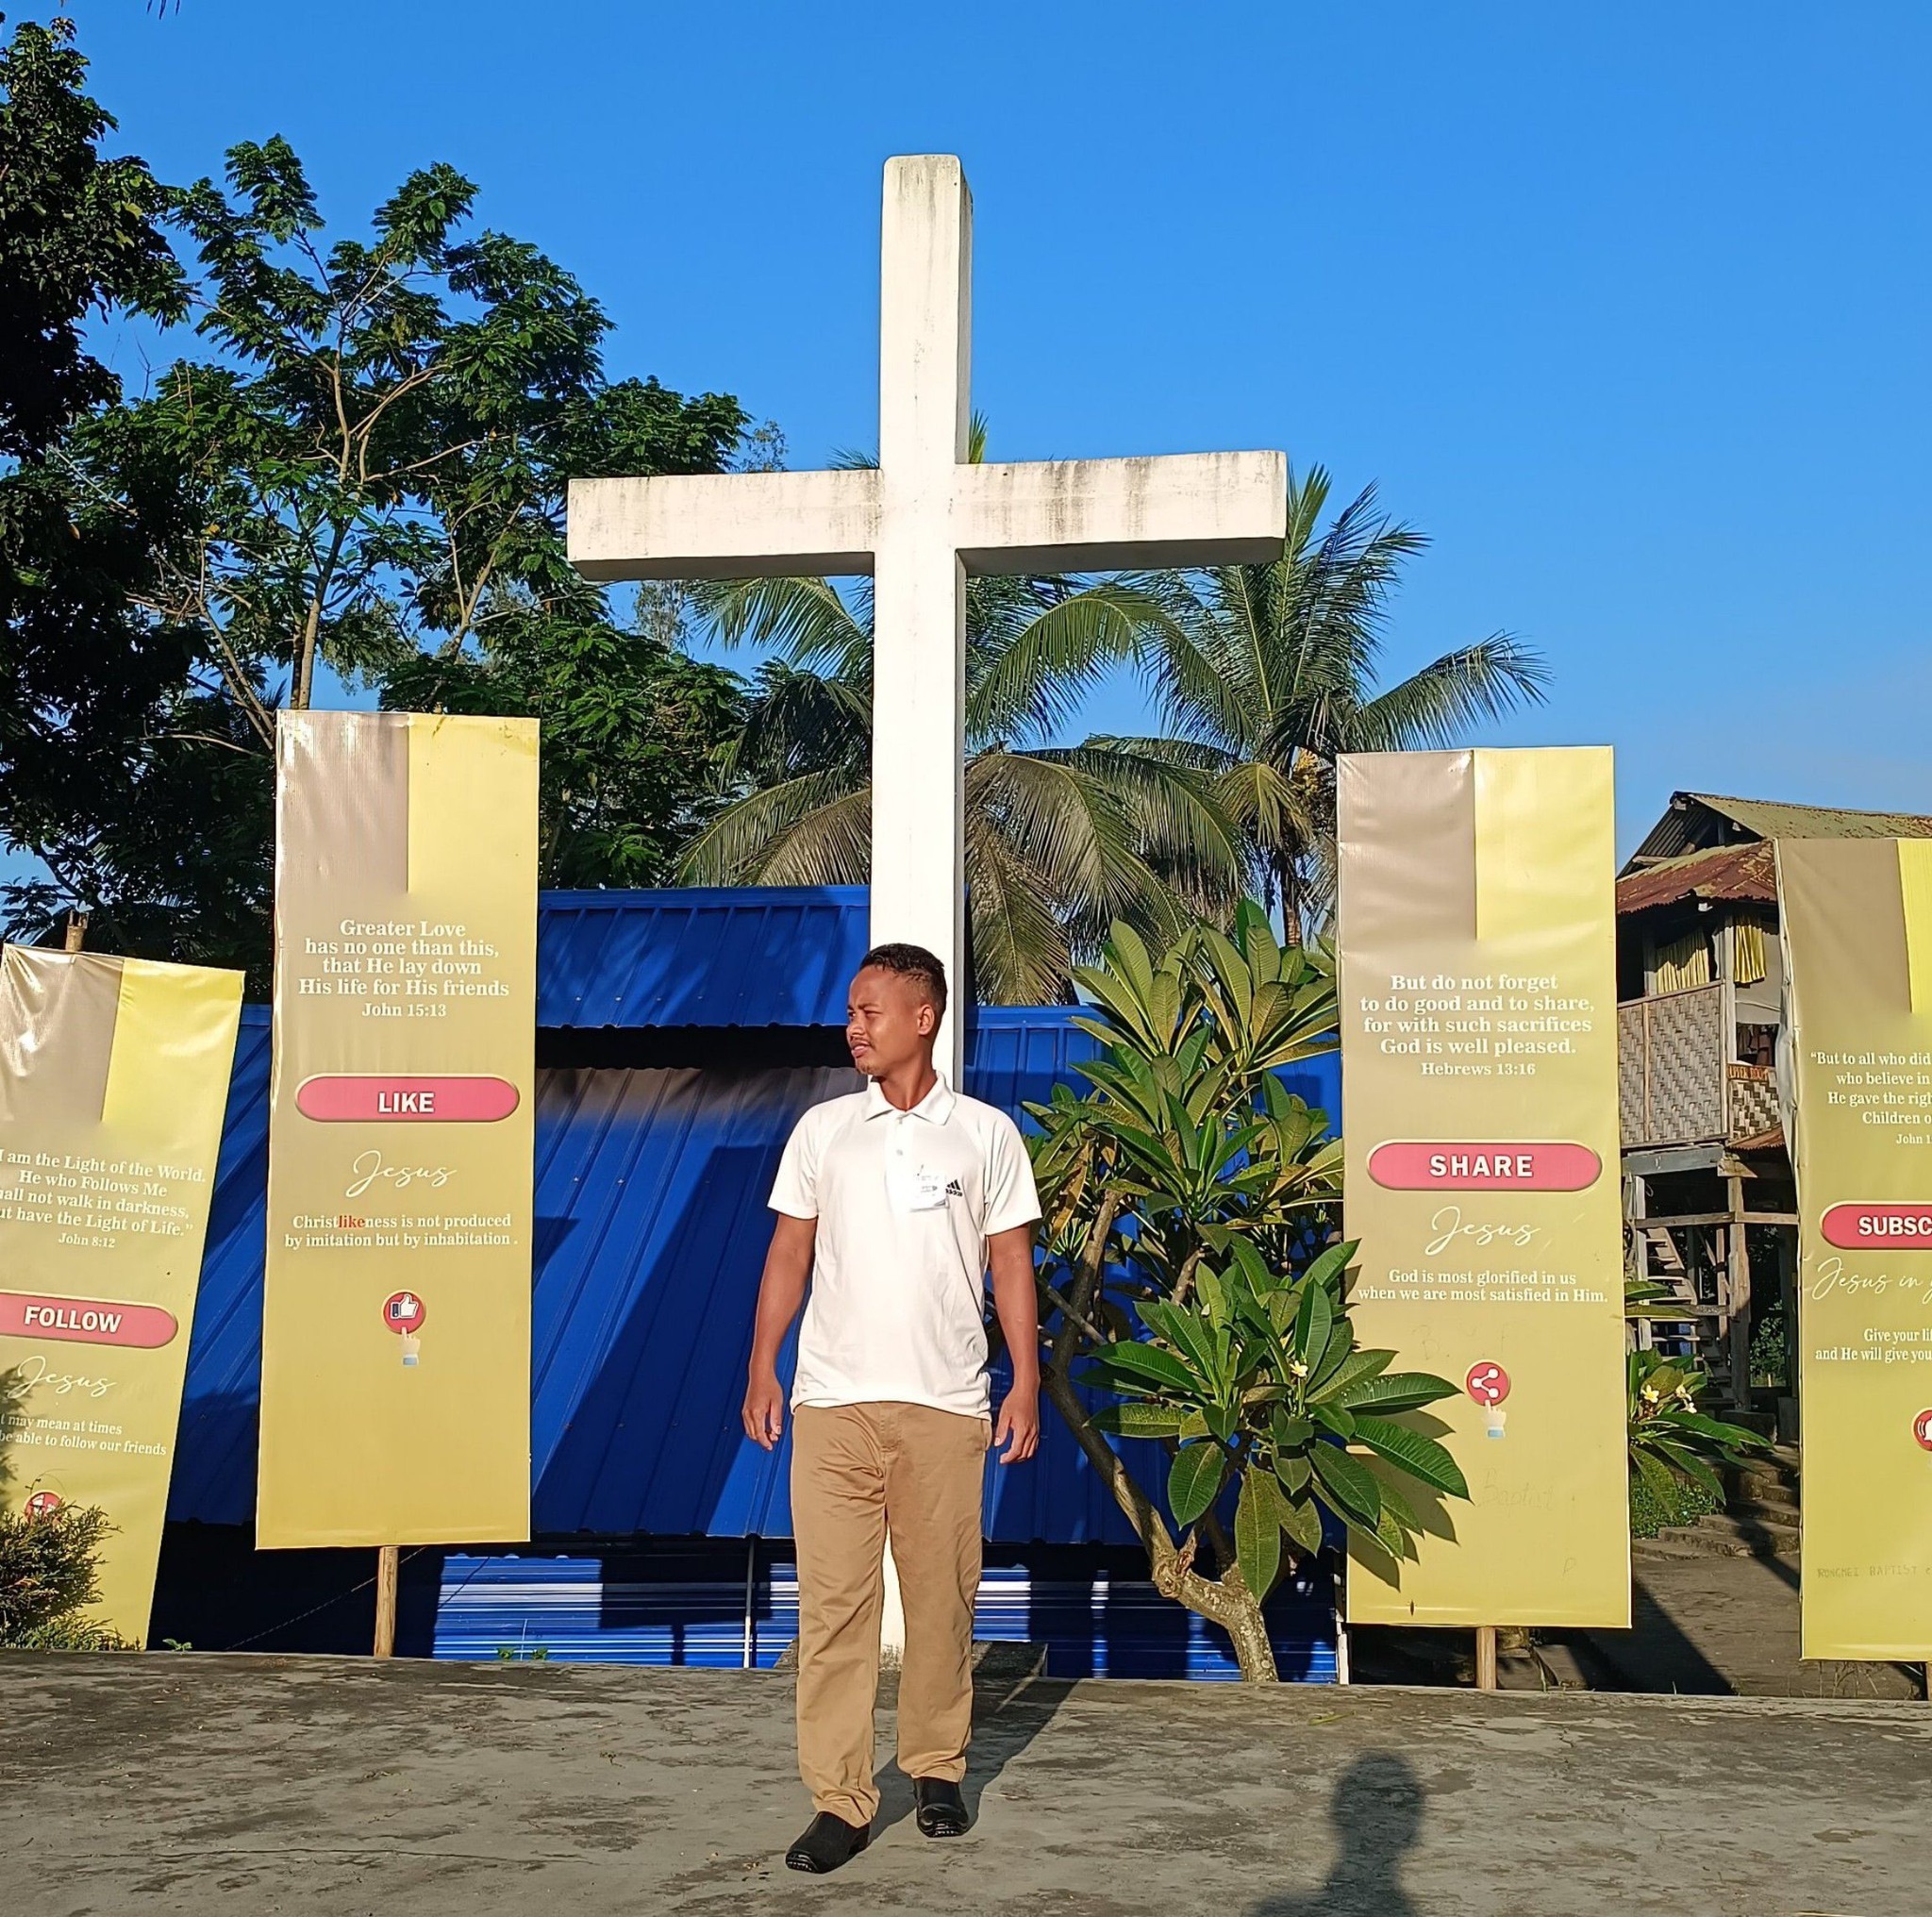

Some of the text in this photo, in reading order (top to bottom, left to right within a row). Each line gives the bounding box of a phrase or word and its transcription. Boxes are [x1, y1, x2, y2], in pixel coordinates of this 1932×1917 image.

[340, 919, 466, 936] Greater Love
[305, 938, 499, 958] has no one than this,
[323, 958, 482, 977] that He lay down
[298, 978, 509, 996] His life for His friends
[1391, 974, 1558, 992] But do not forget
[362, 1003, 447, 1017] John 15:13
[1360, 995, 1595, 1015] to do good and to share,
[1363, 1017, 1592, 1033] for with such sacrifices
[1380, 1038, 1577, 1058] God is well pleased.
[1843, 1053, 1856, 1064] to
[1858, 1052, 1875, 1064] all
[1878, 1053, 1906, 1064] who
[1909, 1053, 1932, 1064] did
[1421, 1062, 1536, 1076] Hebrews 13:16
[1836, 1072, 1930, 1085] who believe in
[377, 1092, 435, 1113] LIKE
[1828, 1092, 1846, 1104] He
[1849, 1094, 1879, 1108] gave
[1883, 1092, 1906, 1104] the
[1862, 1111, 1921, 1125] Children
[1896, 1134, 1923, 1143] John
[8, 1152, 30, 1165] am
[35, 1153, 60, 1168] the
[64, 1156, 106, 1174] Light
[109, 1161, 127, 1175] of
[128, 1162, 153, 1177] the
[158, 1165, 206, 1182] World.
[345, 1149, 458, 1198] Jesus
[1430, 1155, 1534, 1177] SHARE
[19, 1170, 168, 1197] He who Follows Me
[28, 1192, 53, 1205] not
[57, 1194, 92, 1208] walk
[96, 1196, 111, 1210] in
[115, 1198, 191, 1219] darkness,
[16, 1208, 53, 1224] have
[57, 1211, 81, 1226] the
[85, 1215, 127, 1232] Light
[131, 1220, 148, 1232] of
[292, 1214, 511, 1232] Christlikeness is not produced
[58, 1232, 115, 1248] John 8:12
[1424, 1206, 1541, 1257] Jesus
[285, 1234, 302, 1250] by
[306, 1234, 372, 1247] imitation
[375, 1233, 400, 1246] but
[404, 1233, 421, 1249] by
[1389, 1270, 1576, 1288] God is most glorified in us
[1812, 1257, 1892, 1300] Jesus
[1899, 1275, 1923, 1288] in
[1358, 1286, 1608, 1303] when we are most satisfied in Him.
[25, 1306, 123, 1334] FOLLOW
[1864, 1328, 1890, 1342] Give
[1892, 1331, 1919, 1344] your
[1815, 1347, 1838, 1360] and
[1841, 1347, 1857, 1360] He
[1860, 1347, 1881, 1360] will
[1885, 1347, 1907, 1363] give
[8, 1355, 117, 1400] Jesus
[8, 1416, 34, 1430] may
[36, 1419, 70, 1431] mean
[74, 1421, 87, 1432] at
[89, 1421, 123, 1436] times
[15, 1431, 42, 1444] able
[45, 1435, 58, 1446] to
[59, 1435, 97, 1450] follow
[99, 1441, 122, 1452] our
[123, 1441, 167, 1456] friends
[1870, 1564, 1917, 1576] BAPTIST
